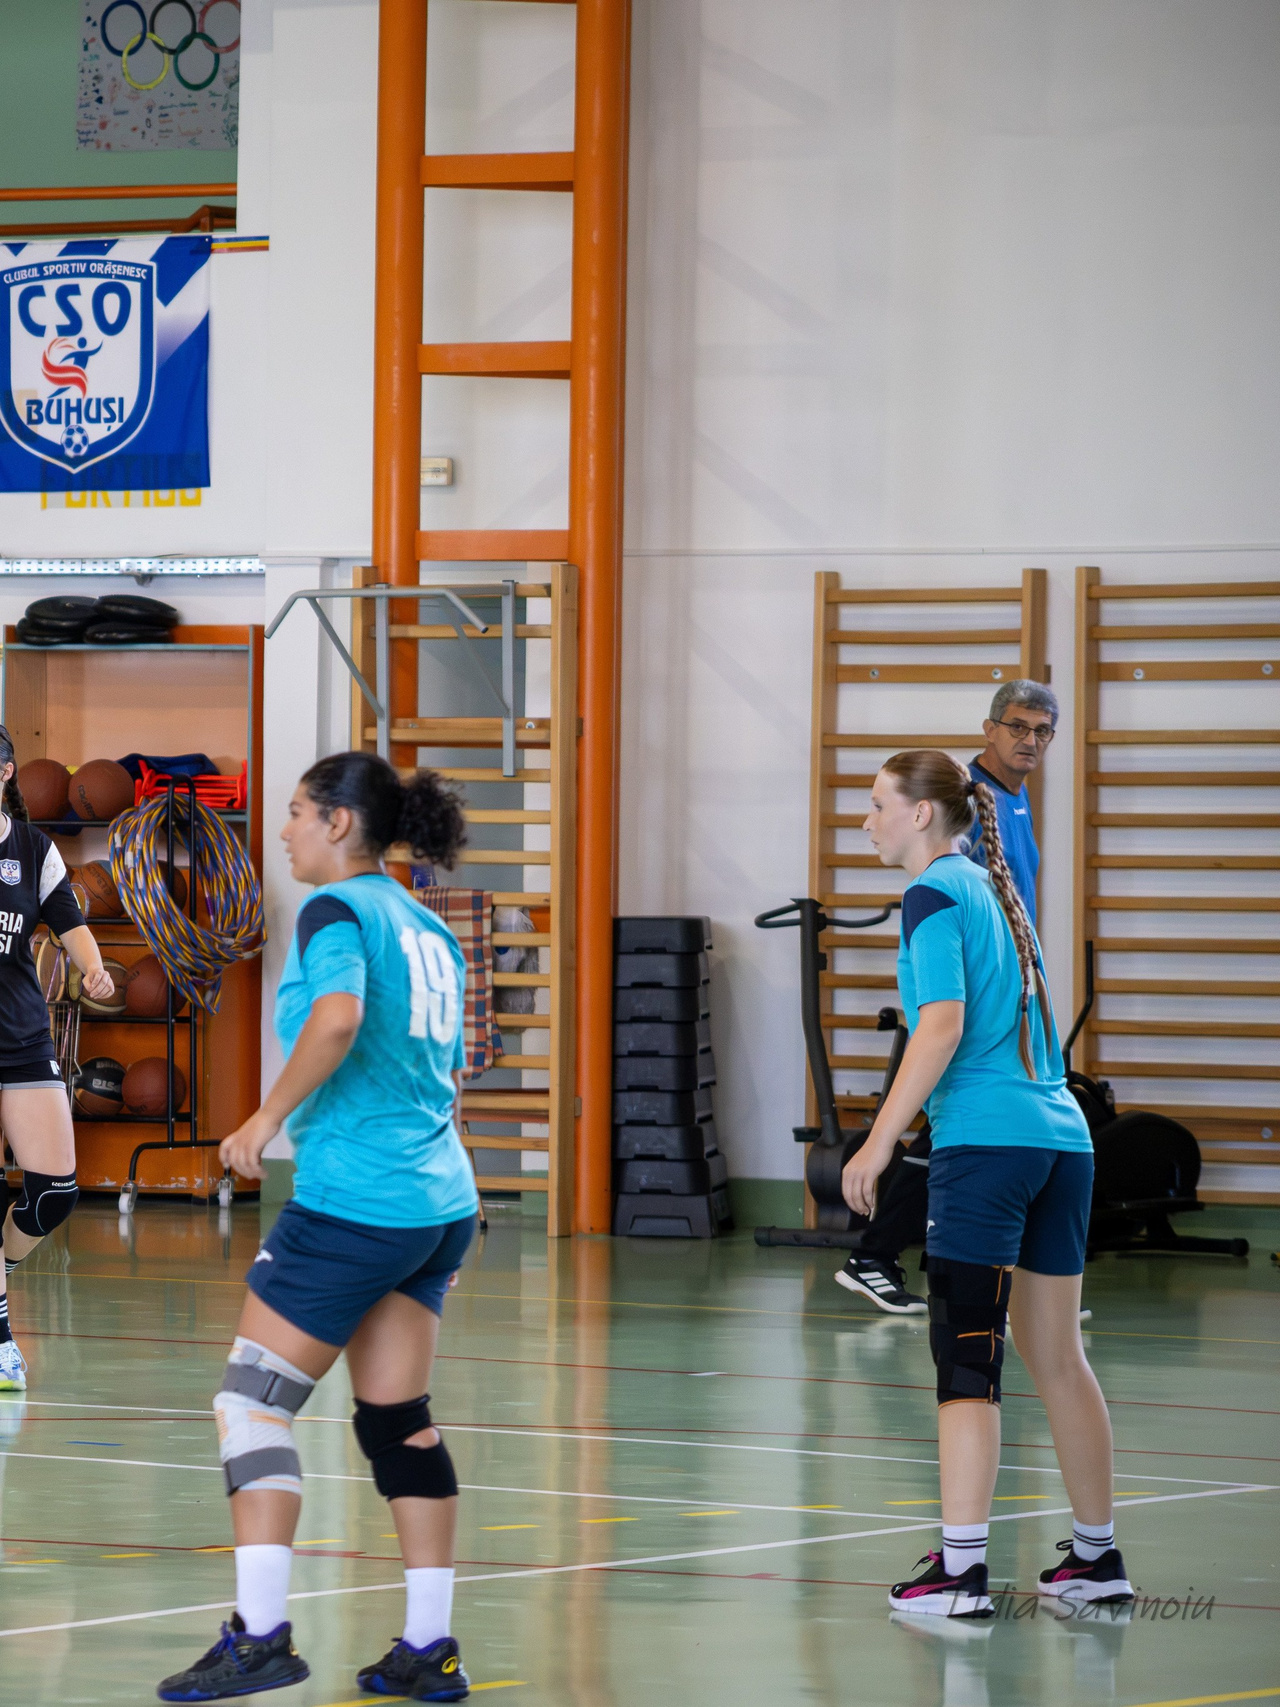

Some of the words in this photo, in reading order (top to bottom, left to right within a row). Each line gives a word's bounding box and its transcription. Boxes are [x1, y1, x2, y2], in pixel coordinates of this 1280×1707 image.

[3, 267, 40, 284] CLUBUL
[43, 263, 87, 276] SPORTIV
[18, 281, 132, 338] CSO
[400, 925, 458, 1046] 19
